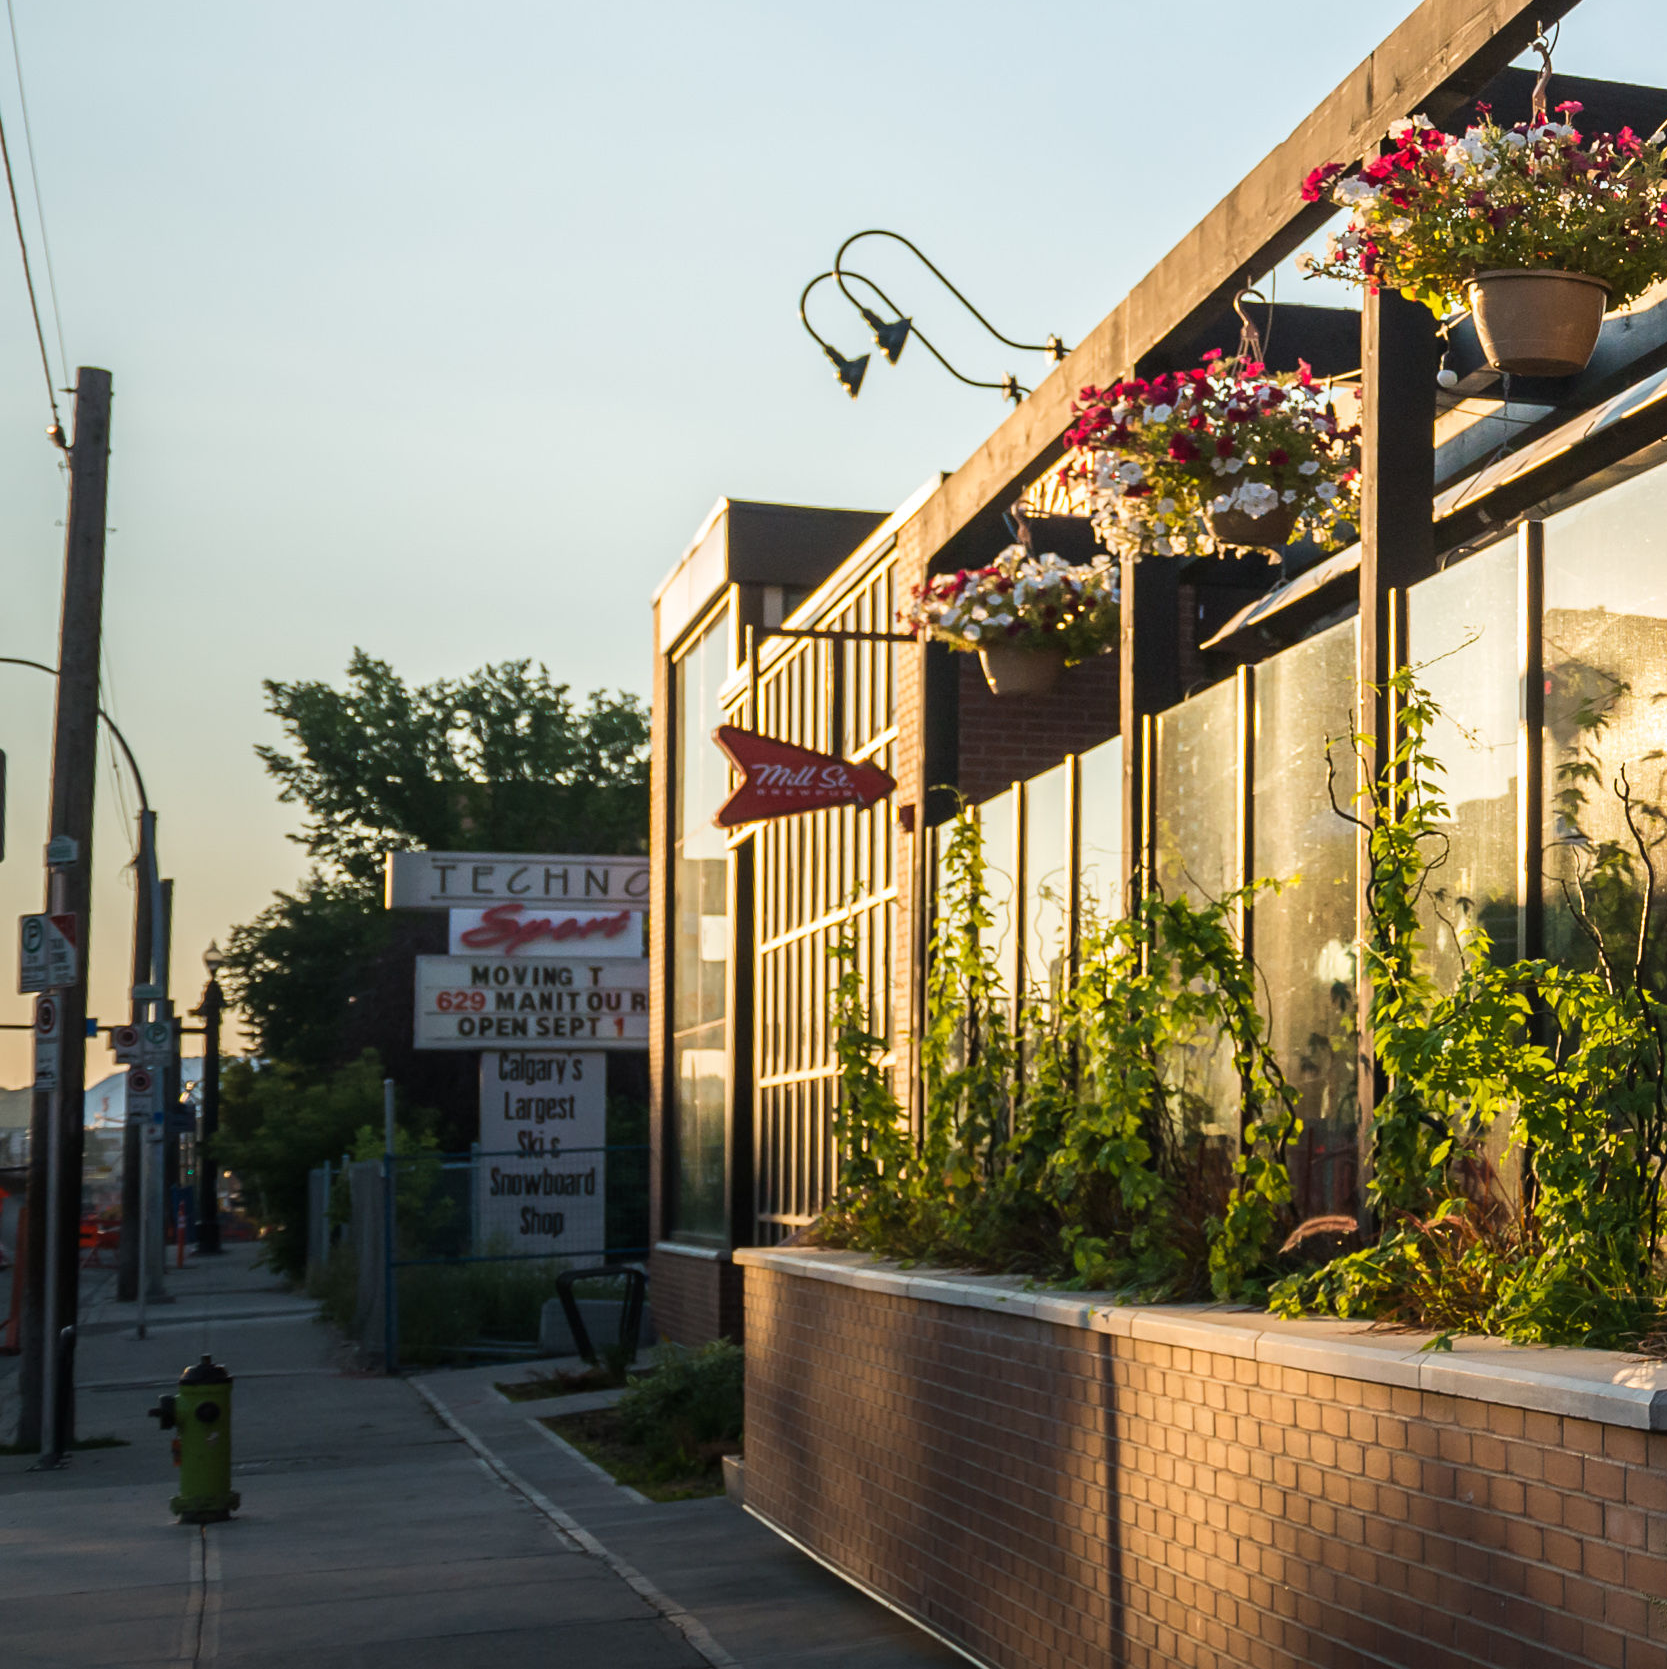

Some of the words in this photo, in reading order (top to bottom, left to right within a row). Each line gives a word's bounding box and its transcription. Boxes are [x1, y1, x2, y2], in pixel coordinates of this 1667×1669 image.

[752, 763, 817, 787] Mill
[818, 764, 855, 788] St.
[432, 864, 650, 897] TECHNO
[461, 903, 631, 956] Sport
[471, 966, 573, 987] MOVING
[436, 990, 487, 1013] 629
[495, 992, 622, 1012] MANITOU
[458, 1017, 528, 1038] OPEN
[536, 1017, 601, 1038] SEPT
[498, 1051, 583, 1084] Calgary's
[504, 1091, 576, 1125] Largest
[517, 1130, 544, 1159] Ski
[490, 1166, 596, 1197] Snowboard
[520, 1205, 565, 1239] Shop
